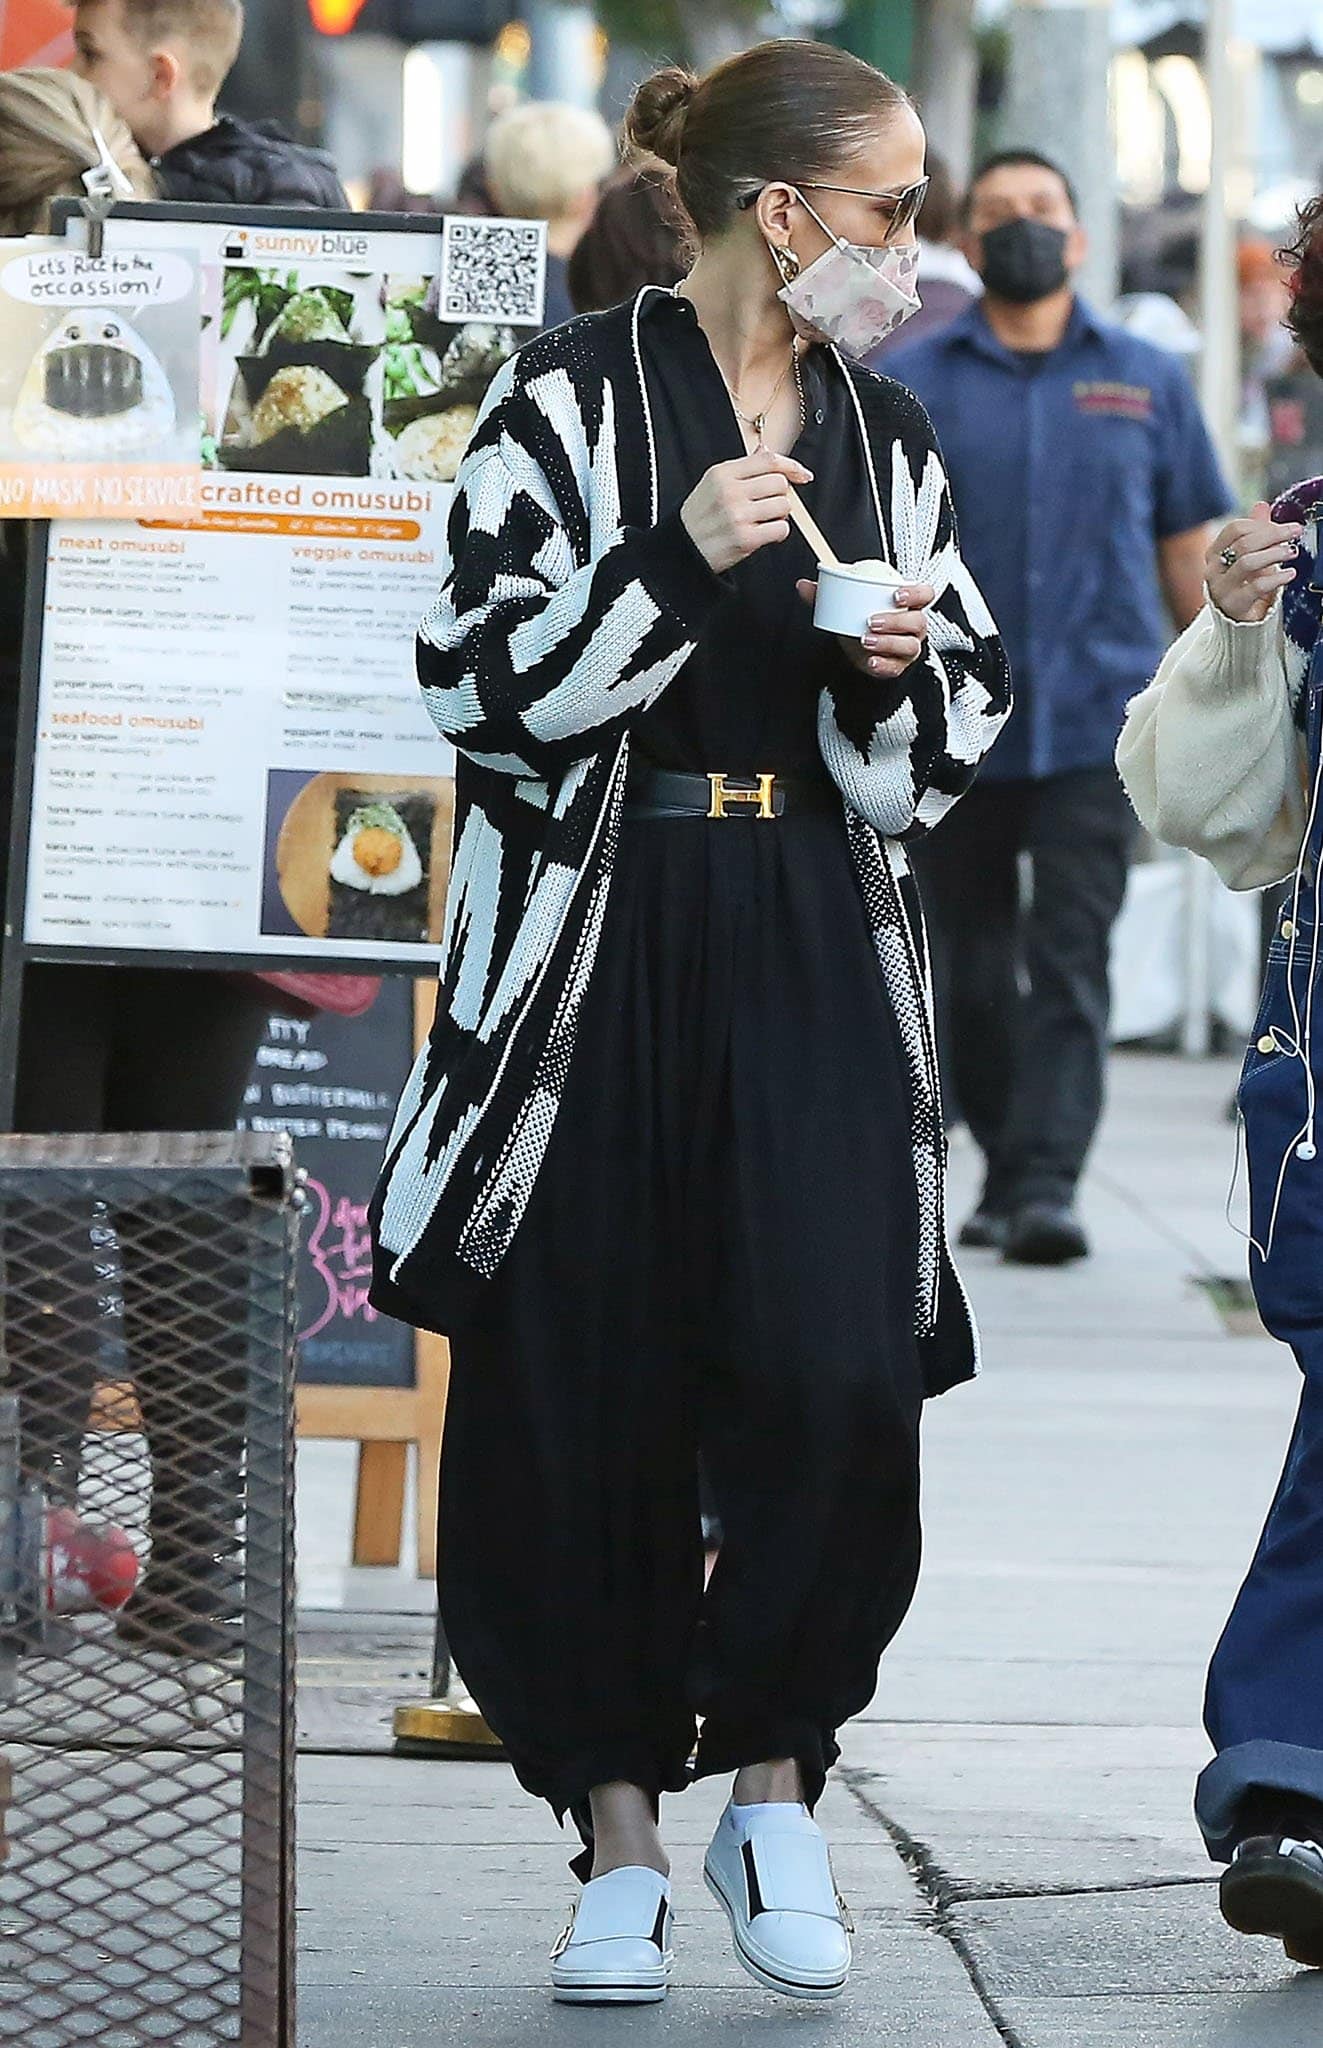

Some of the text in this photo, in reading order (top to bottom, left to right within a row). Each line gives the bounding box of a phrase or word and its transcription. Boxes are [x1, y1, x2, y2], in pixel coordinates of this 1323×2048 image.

[255, 234, 368, 255] sunny blue
[28, 258, 66, 277] Let's
[113, 260, 128, 272] to
[0, 475, 196, 506] NO MASK NO SERVICE
[200, 482, 432, 511] crafted omusubi
[58, 537, 185, 554] meat omusubi
[292, 548, 434, 563] veggie omusubi
[51, 711, 205, 730] seafood omusubi
[706, 773, 776, 818] H
